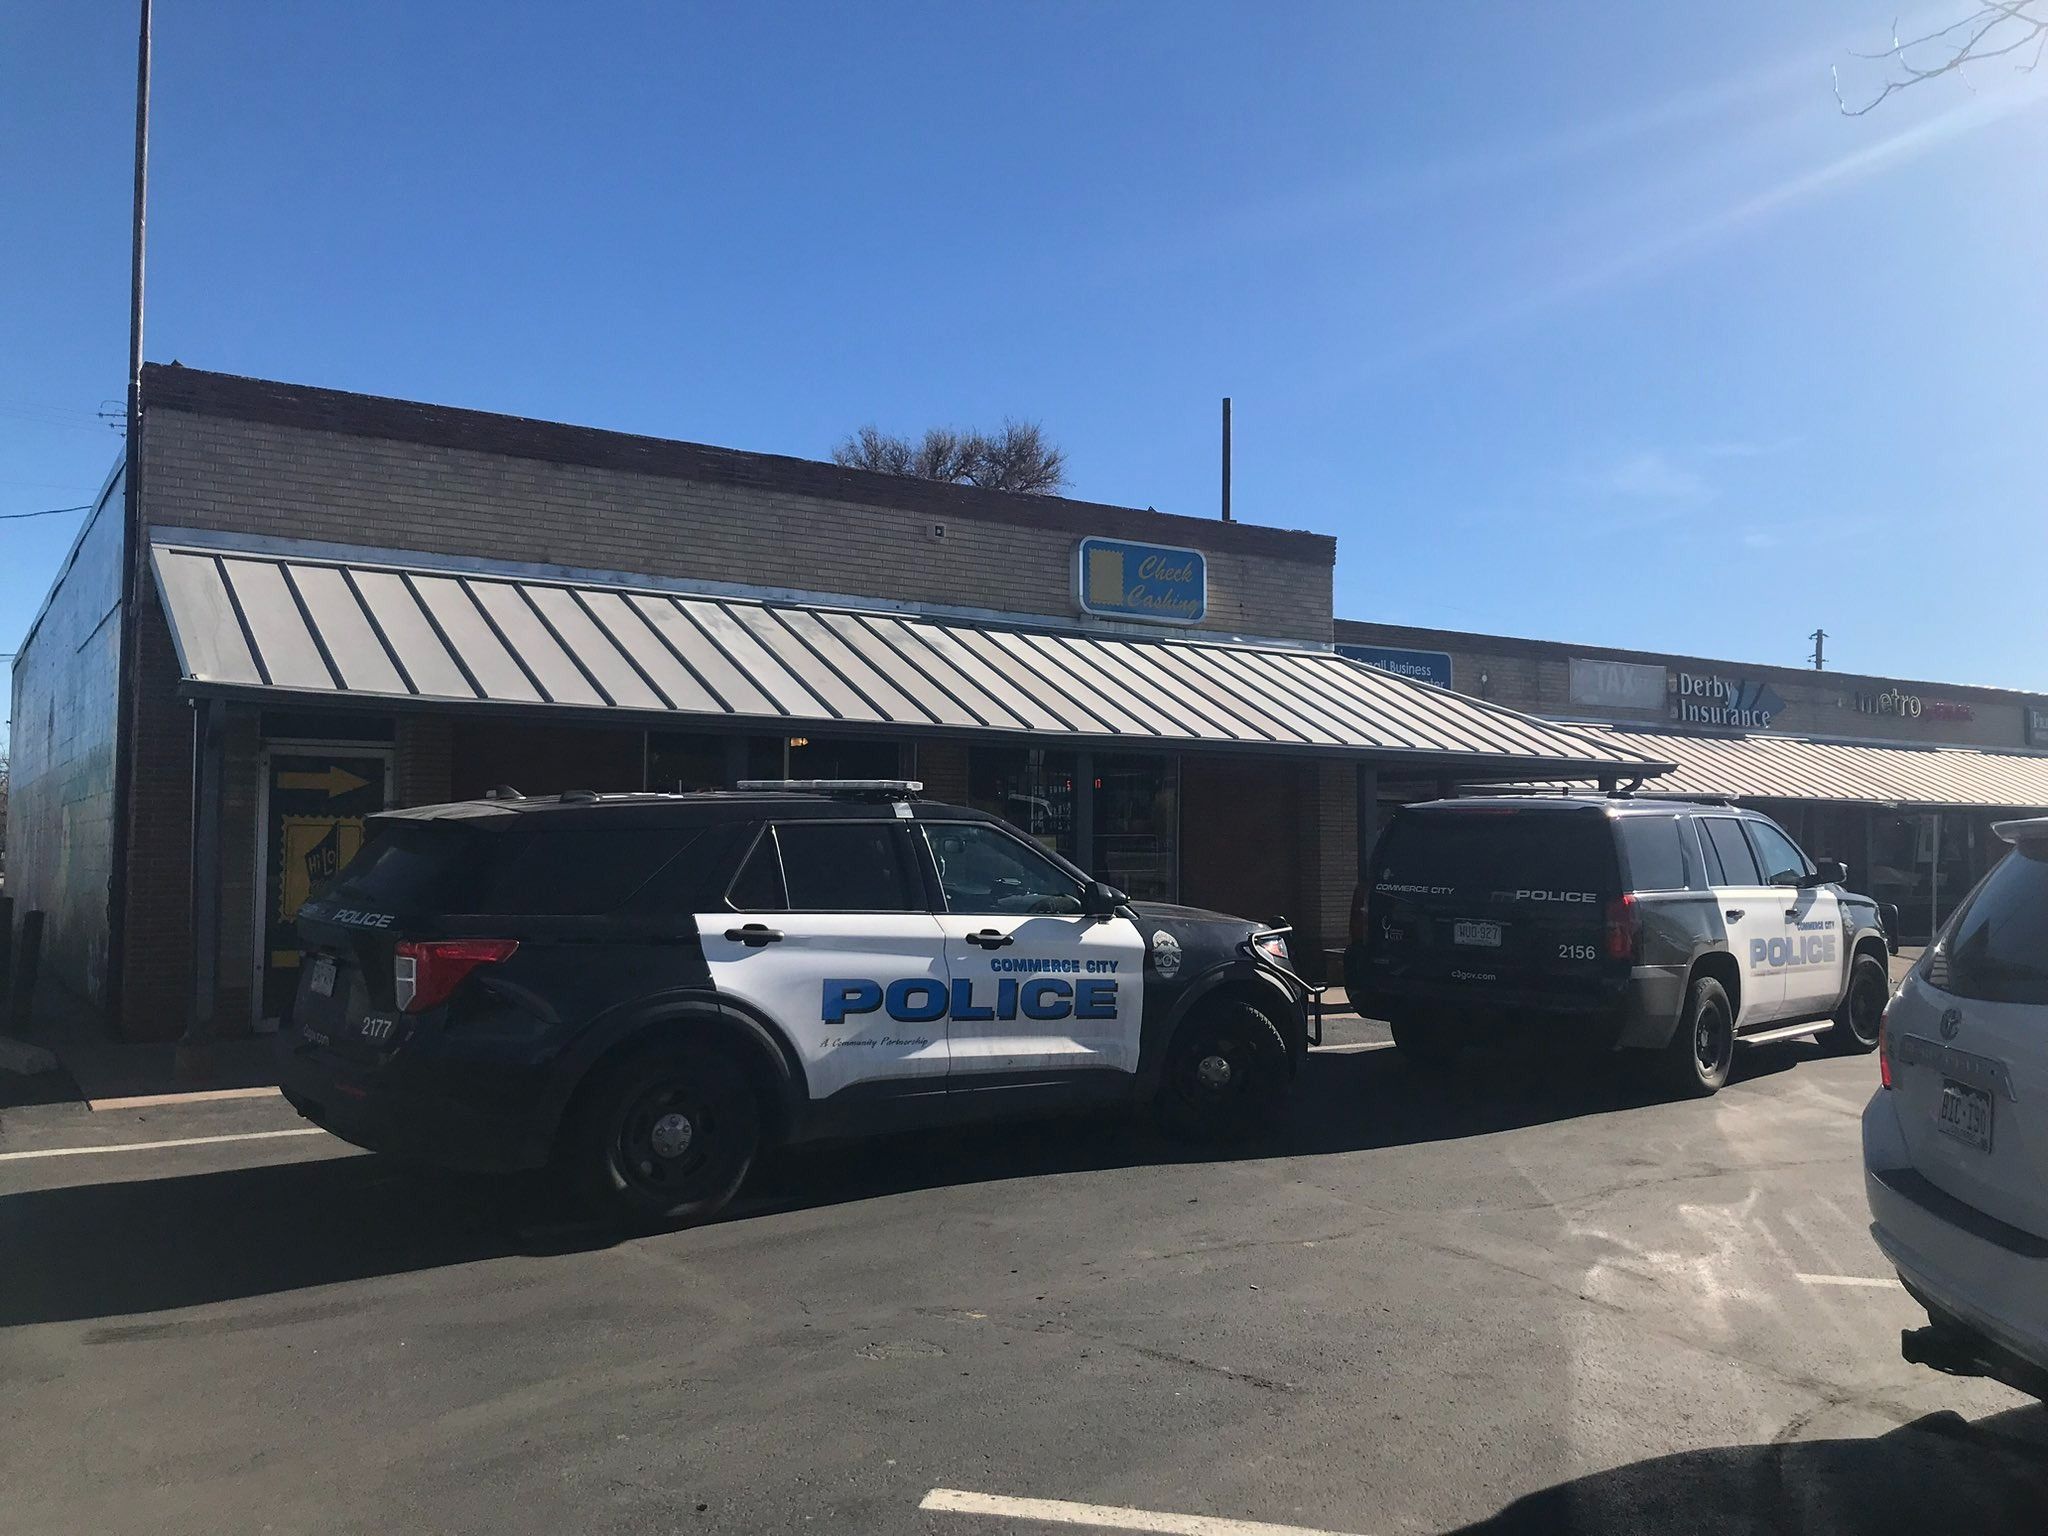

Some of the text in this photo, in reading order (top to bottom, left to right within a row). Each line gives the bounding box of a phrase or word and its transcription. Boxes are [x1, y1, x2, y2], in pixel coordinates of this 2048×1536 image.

[1138, 555, 1193, 583] Check
[1127, 584, 1202, 619] Cashing
[1390, 660, 1432, 676] Business
[1594, 665, 1636, 697] TAX
[1680, 672, 1732, 705] Derby
[1681, 699, 1770, 728] Insurance
[1860, 688, 1921, 718] metro
[1375, 882, 1455, 895] COMMERCE CITY
[1515, 889, 1597, 904] POLICE
[333, 908, 395, 928] POLICE
[1797, 920, 1835, 931] COMMERCE CITY
[1558, 944, 1596, 960] 2156
[1750, 934, 1836, 969] POLICE
[990, 957, 1119, 974] COMMERCE CITY
[1451, 970, 1496, 982] c3gov.com
[821, 977, 1119, 1025] POLICE
[361, 1016, 392, 1039] 2177
[820, 1036, 928, 1048] A Community Partnership
